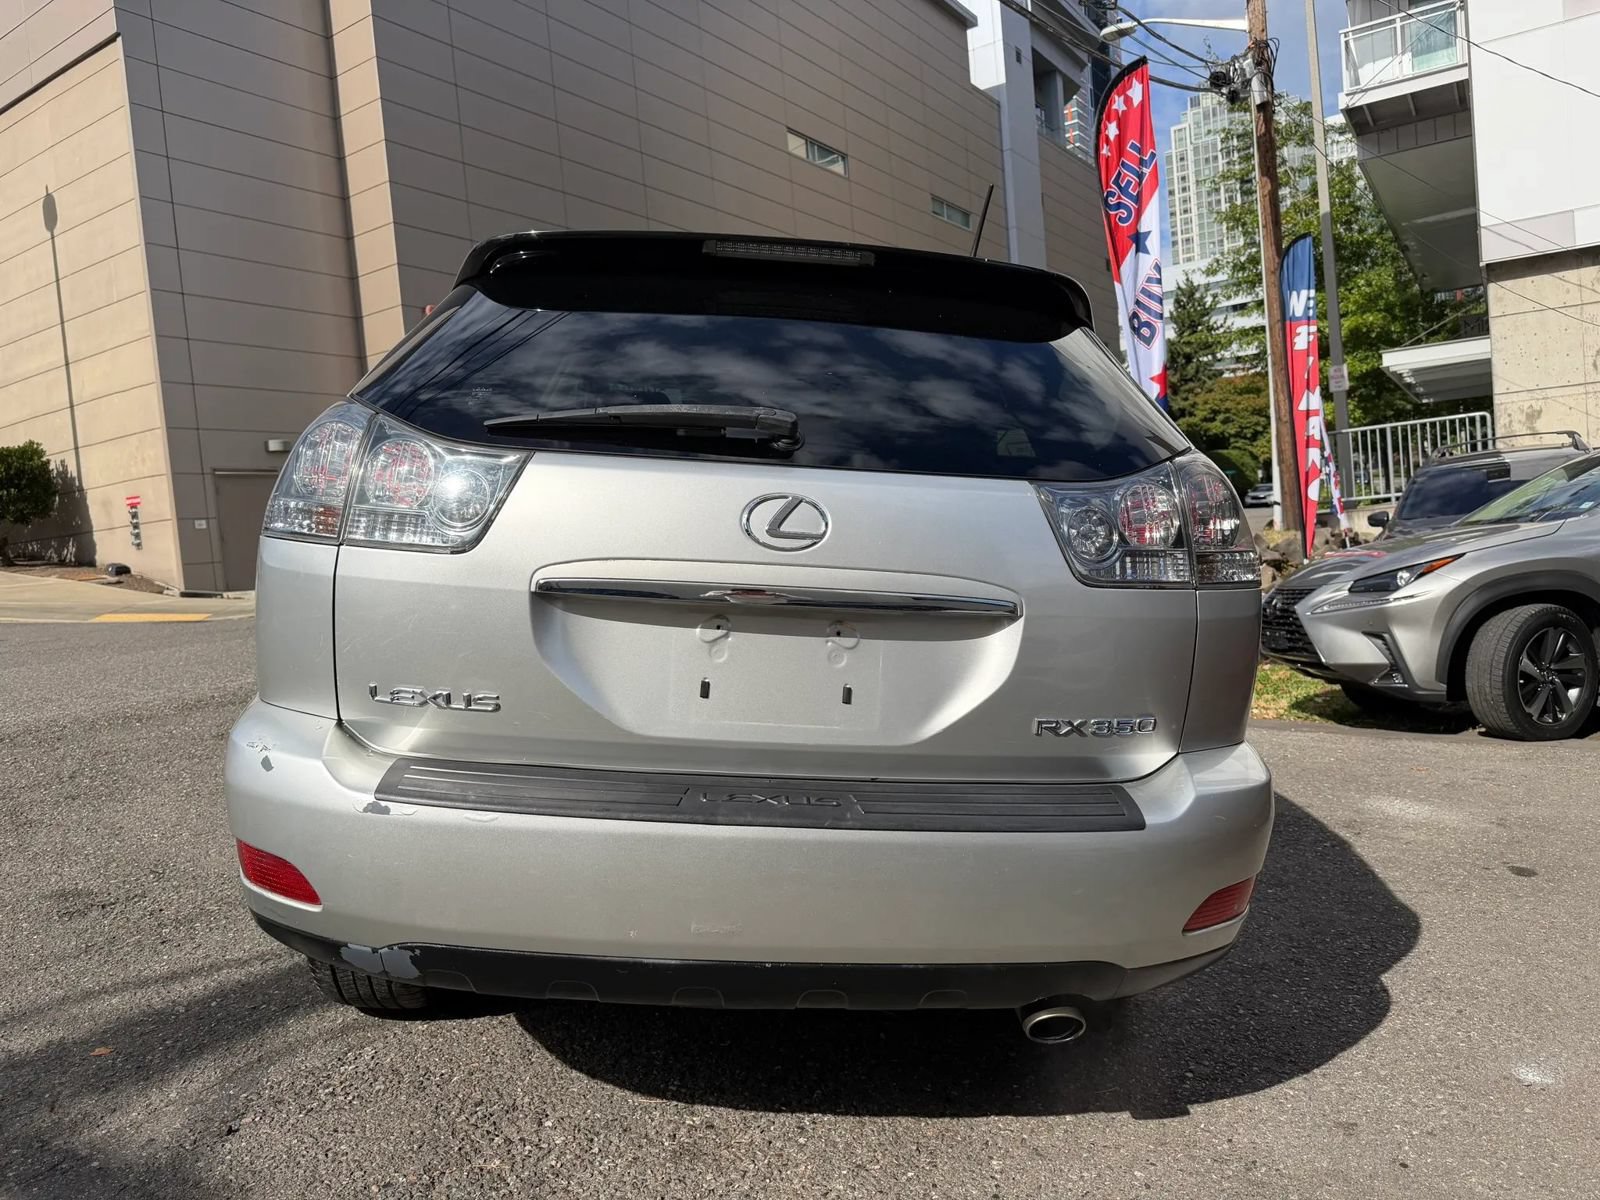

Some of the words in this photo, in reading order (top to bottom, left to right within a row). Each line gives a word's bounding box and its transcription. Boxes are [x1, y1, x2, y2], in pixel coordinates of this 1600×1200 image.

[1103, 139, 1157, 226] SELL
[1129, 259, 1164, 350] BUY
[368, 682, 502, 712] LEXUS
[700, 791, 842, 808] LEXUS
